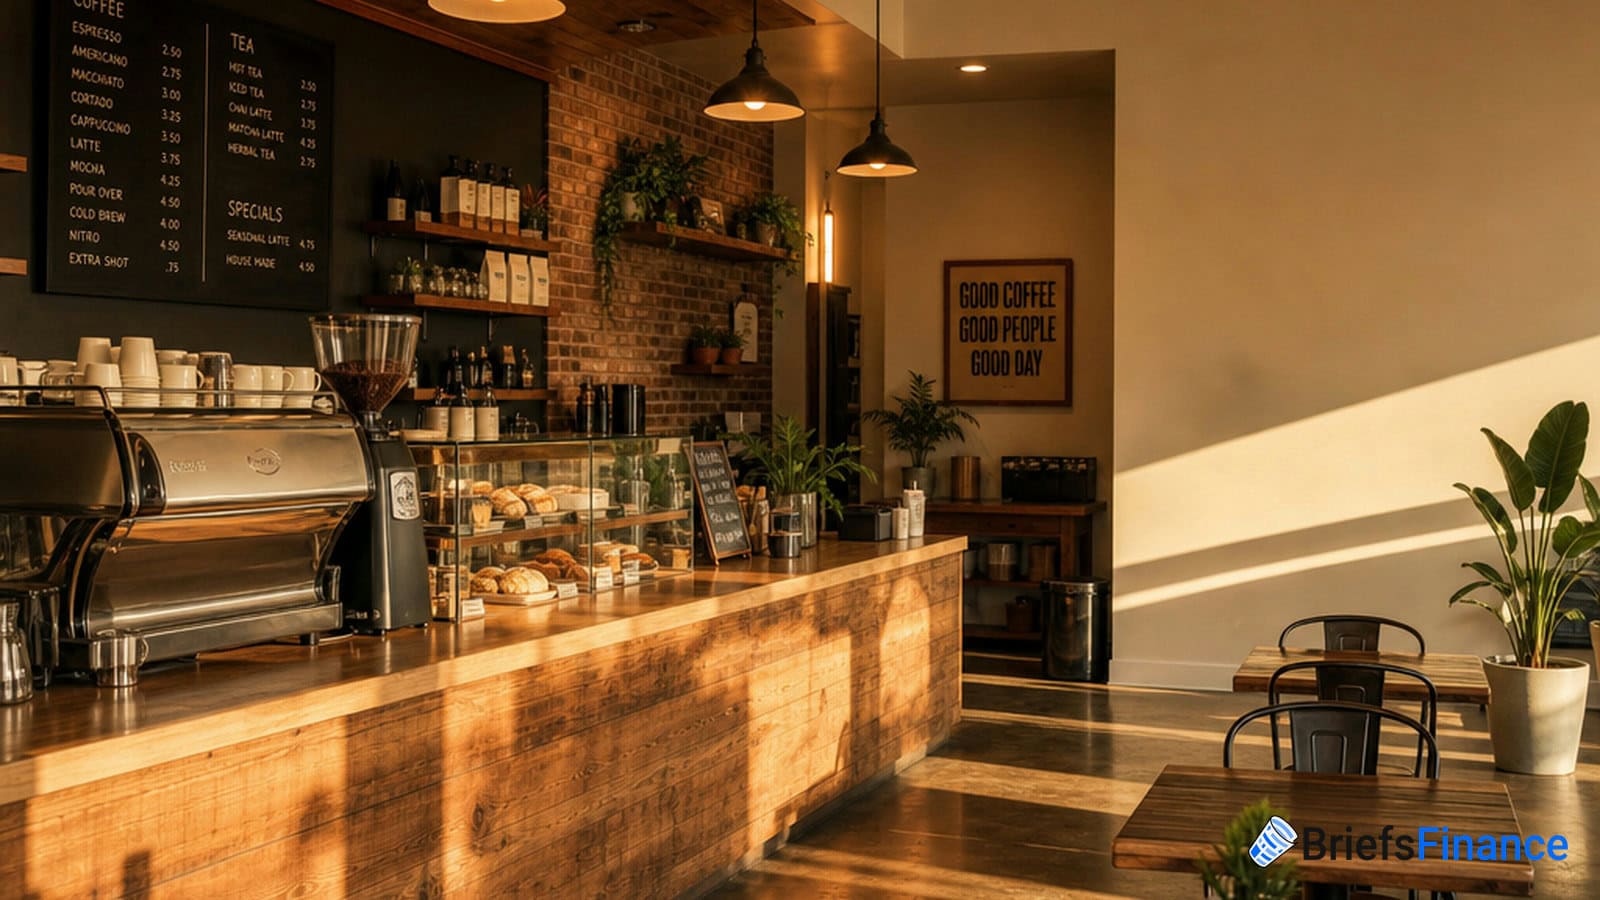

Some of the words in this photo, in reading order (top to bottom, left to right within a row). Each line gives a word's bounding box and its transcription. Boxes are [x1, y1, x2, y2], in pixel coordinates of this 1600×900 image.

[72, 21, 122, 44] ESPRESSO
[162, 44, 182, 59] 2.50
[230, 32, 255, 55] TEA
[71, 44, 128, 68] AMERICANO
[162, 66, 182, 80] 2.75
[247, 64, 263, 78] TEA
[71, 67, 125, 89] MACCHIATO
[162, 87, 181, 101] 3.00
[249, 85, 265, 98] TEA
[71, 91, 114, 109] CORTADO
[70, 113, 131, 135] CAPPUCCINO
[249, 106, 273, 121] LATTE
[228, 121, 260, 137] MATCHA
[262, 128, 285, 143] LATTE
[70, 137, 101, 152] LATTE
[161, 152, 181, 166] 3.75
[260, 147, 276, 161] TEA
[70, 160, 105, 176] MOCHA
[69, 182, 97, 197] POUR
[98, 187, 123, 201] OVER
[69, 206, 96, 220] COLD
[98, 209, 126, 223] BREW
[228, 200, 284, 223] SPECIALS
[69, 229, 100, 243] NITRO
[227, 229, 267, 244] SEASONAL
[267, 234, 291, 247] LATTE
[69, 252, 101, 265] EXTRA
[103, 255, 129, 268] SHOT
[165, 261, 180, 273] .75
[226, 254, 253, 266] HOUSE
[254, 257, 277, 269] MADE
[959, 281, 999, 309] GOOD
[1003, 281, 1057, 309] COFFEE
[959, 315, 998, 343] GOOD
[1002, 315, 1057, 343] PEOPLE
[971, 350, 1010, 377] GOOD
[1015, 350, 1043, 377] DAY
